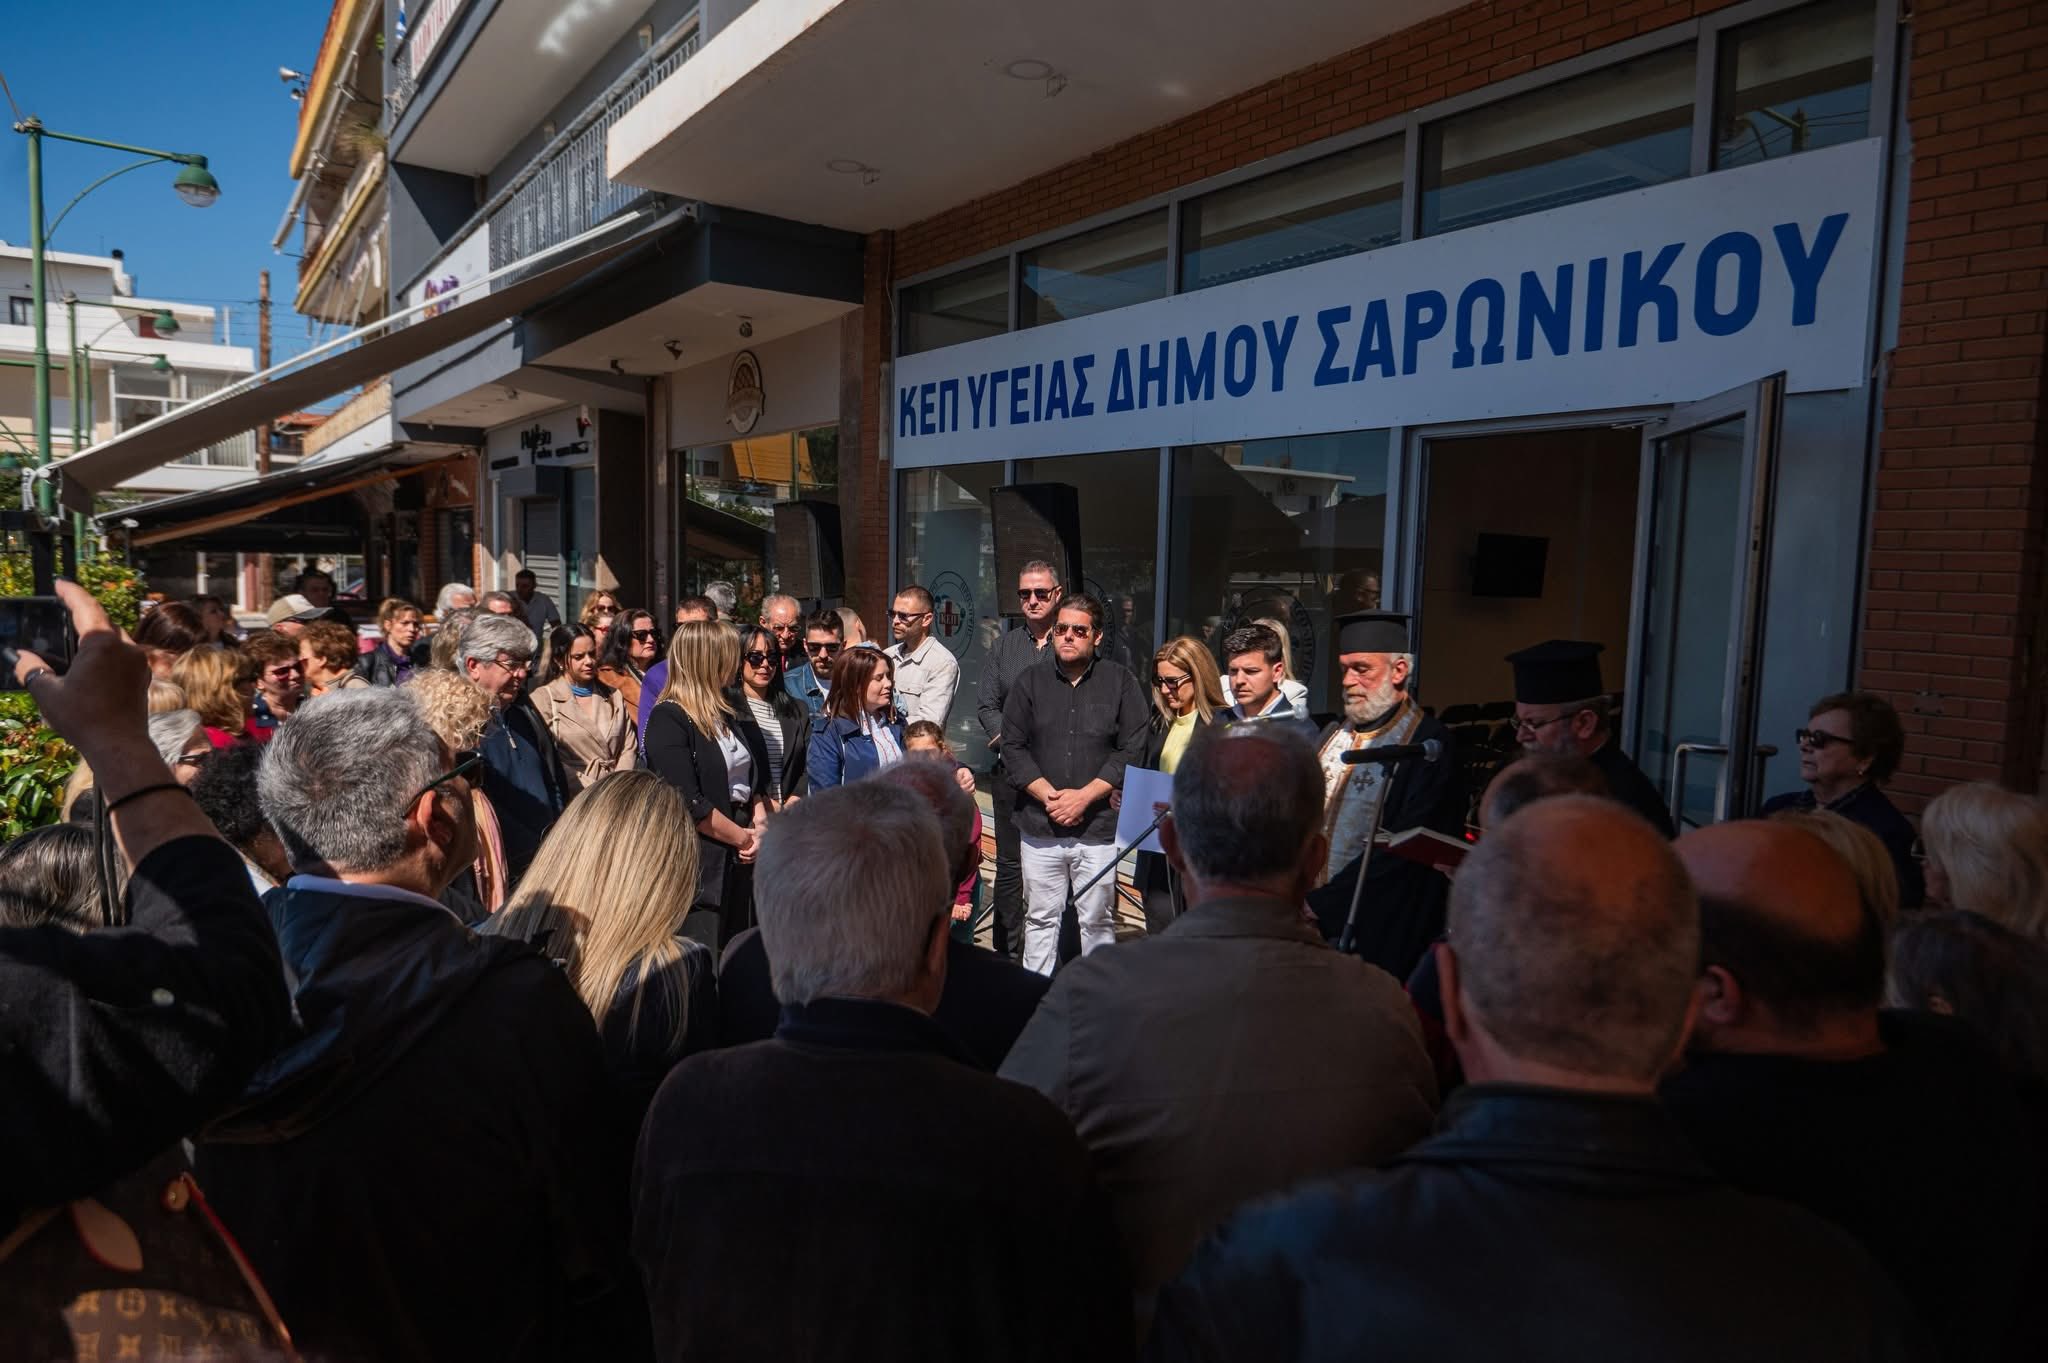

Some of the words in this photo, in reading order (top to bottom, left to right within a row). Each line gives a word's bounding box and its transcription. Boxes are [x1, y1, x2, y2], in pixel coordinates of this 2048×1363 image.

[899, 378, 960, 437] ΚΕΠ
[967, 353, 1096, 430] ΥΓΕΙΑΣ
[1106, 315, 1300, 414] ΔΗΜΟΥ
[1313, 212, 1849, 387] ΣΑΡΩΝΙΚΟΥ
